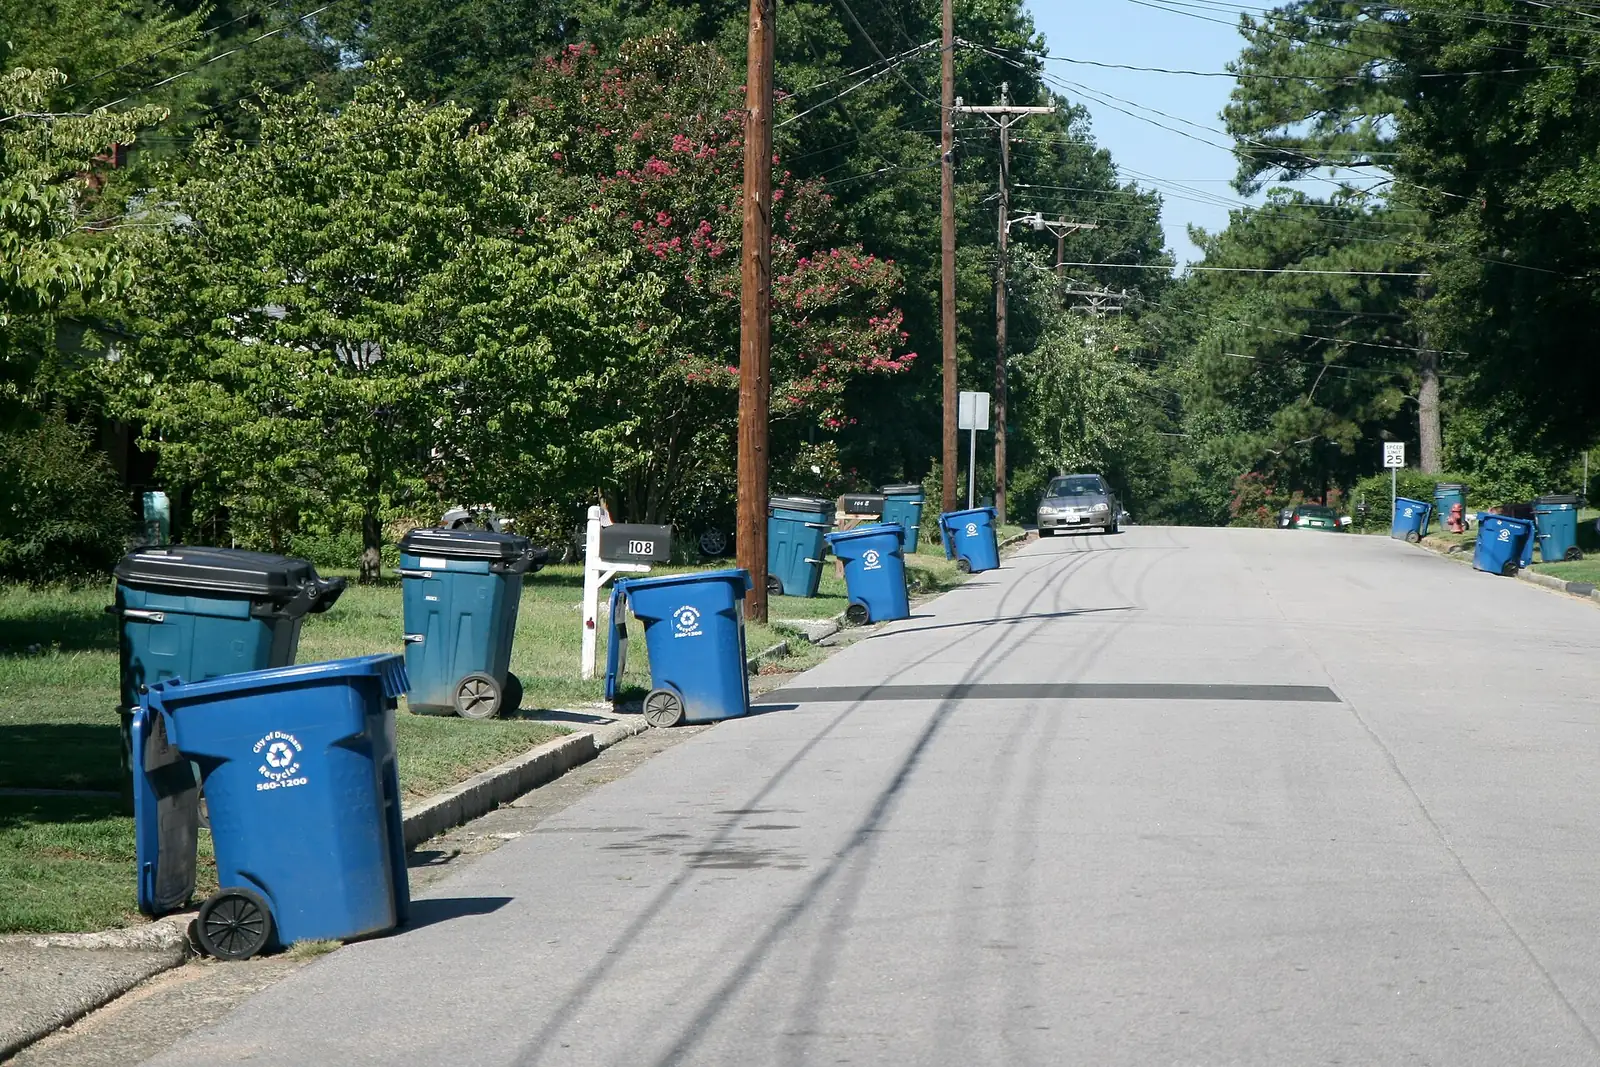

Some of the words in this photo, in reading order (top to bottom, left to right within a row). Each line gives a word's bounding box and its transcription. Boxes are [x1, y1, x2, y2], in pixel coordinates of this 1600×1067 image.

[1386, 455, 1403, 464] 25
[629, 541, 653, 554] 108
[252, 738, 266, 753] City
[265, 731, 274, 740] of
[274, 731, 302, 752] Durham
[258, 762, 300, 781] Recycles
[256, 777, 308, 791] 560-1200
